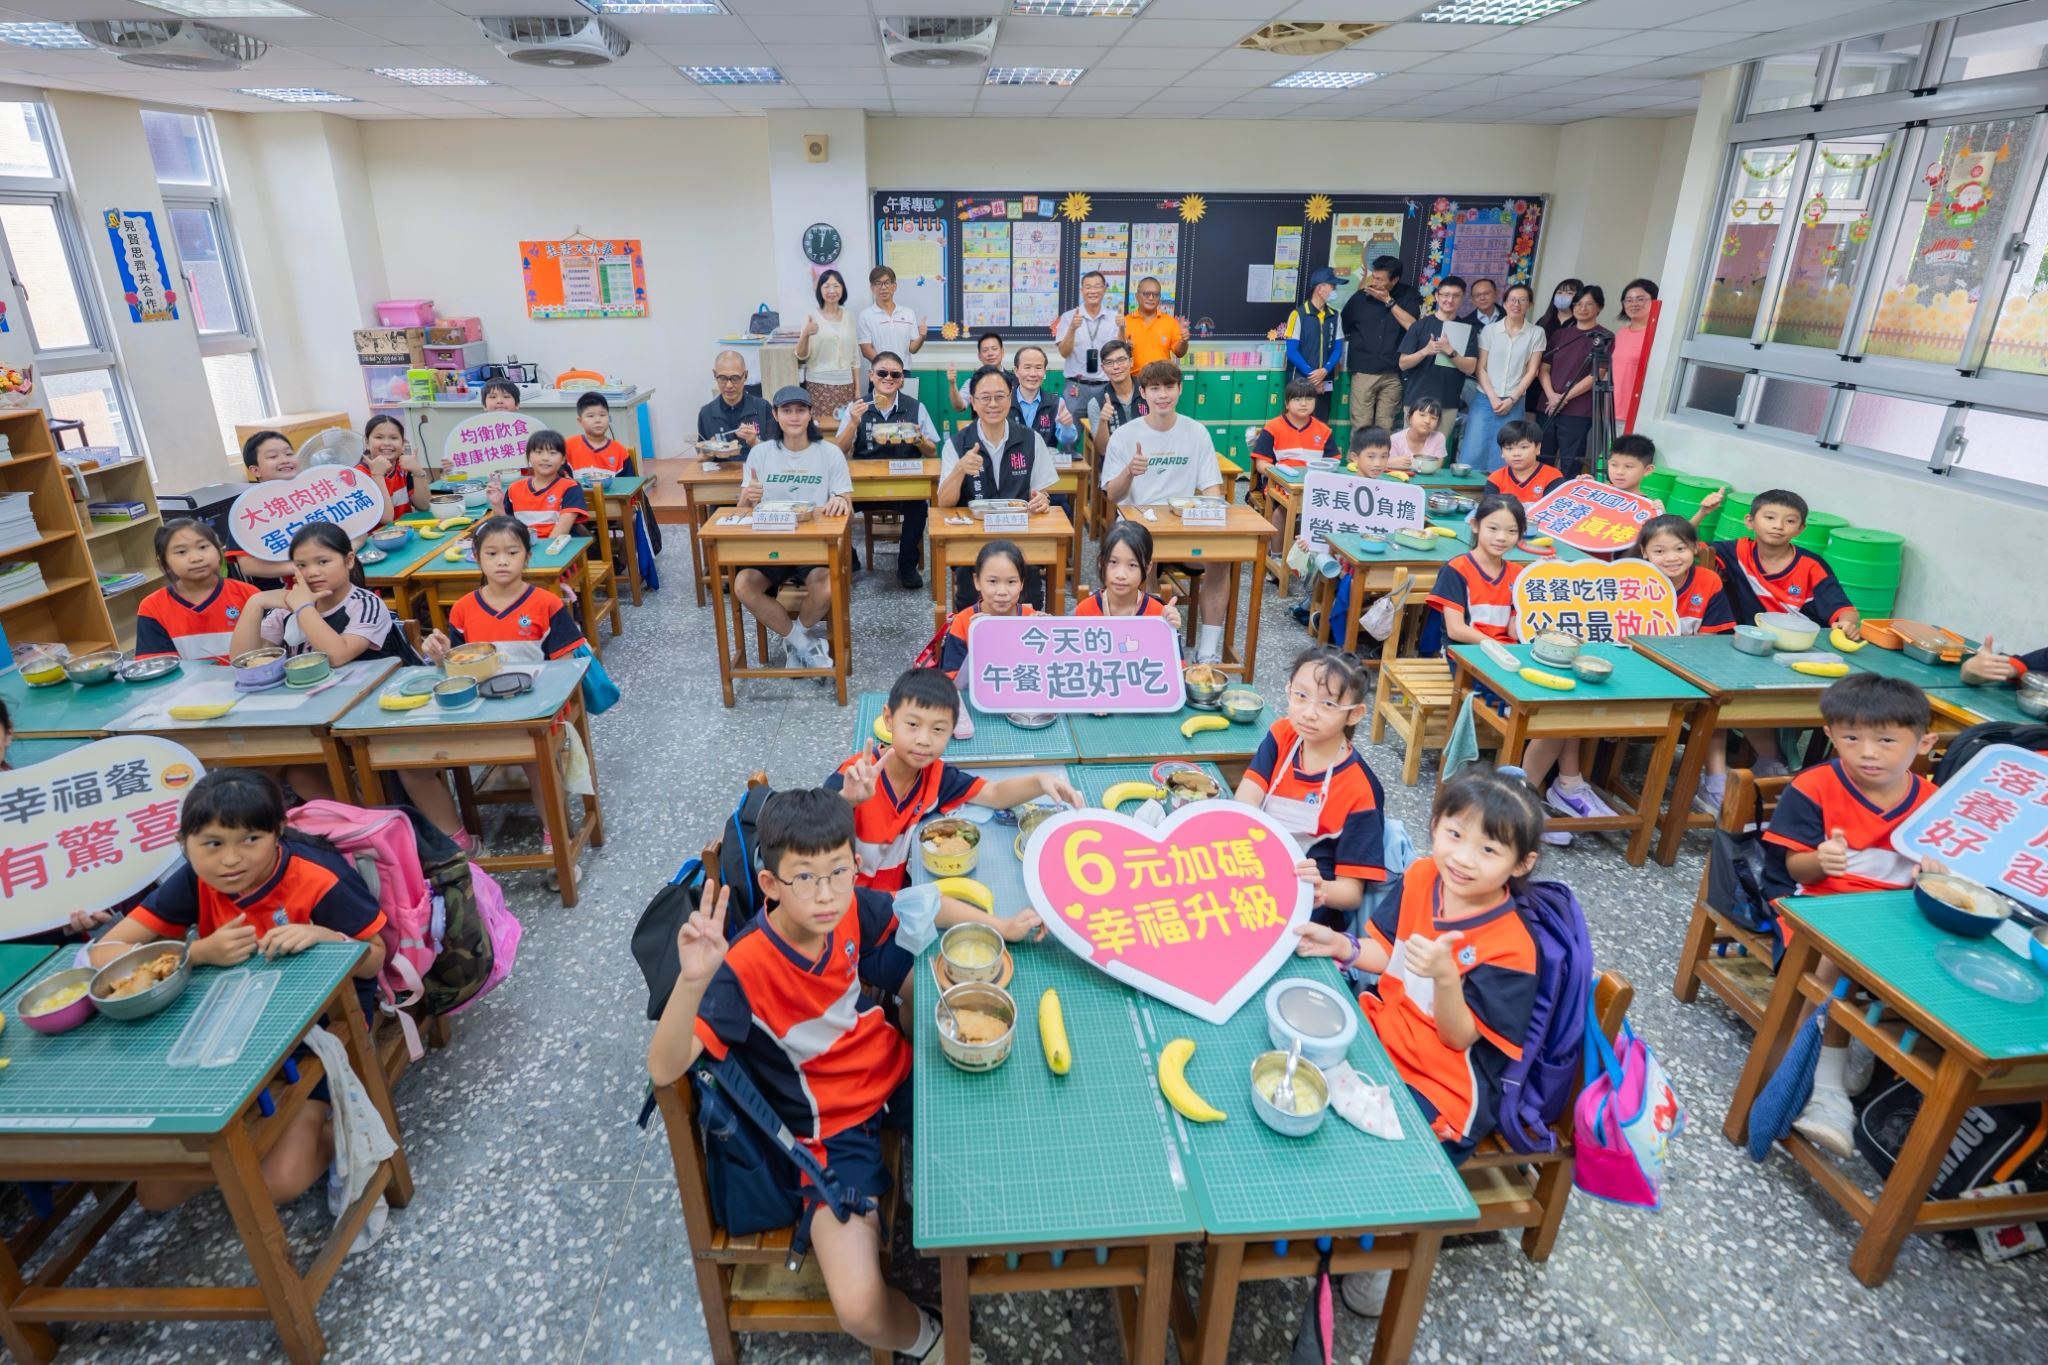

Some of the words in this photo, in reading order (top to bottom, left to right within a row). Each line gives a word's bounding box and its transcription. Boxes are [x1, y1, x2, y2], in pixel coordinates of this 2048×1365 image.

[886, 196, 937, 212] 午餐專區
[993, 197, 1053, 217] 我的作品
[123, 220, 158, 309] 見賢思齊共合作
[460, 419, 529, 444] 均衡飲食
[1149, 456, 1189, 466] OPARDS
[766, 473, 823, 484] LEOPARDS
[240, 478, 338, 529] 大塊肉排
[1311, 486, 1416, 520] 家長0負擔
[1550, 497, 1593, 521] 營養
[1571, 486, 1638, 512] 仁和國小
[1536, 510, 1575, 533] 午餐
[1576, 516, 1638, 543] 真棒
[1525, 578, 1666, 602] 餐餐吃得安心
[1527, 610, 1675, 643] 父母最放心
[1021, 627, 1112, 654] 今天的
[983, 658, 1168, 699] 午餐超好吃
[0, 759, 152, 824] 幸福餐
[1984, 762, 2048, 806] 落
[0, 799, 181, 898] 有驚喜
[1064, 829, 1265, 896] 6元加碼
[1086, 884, 1287, 955] 幸福升級
